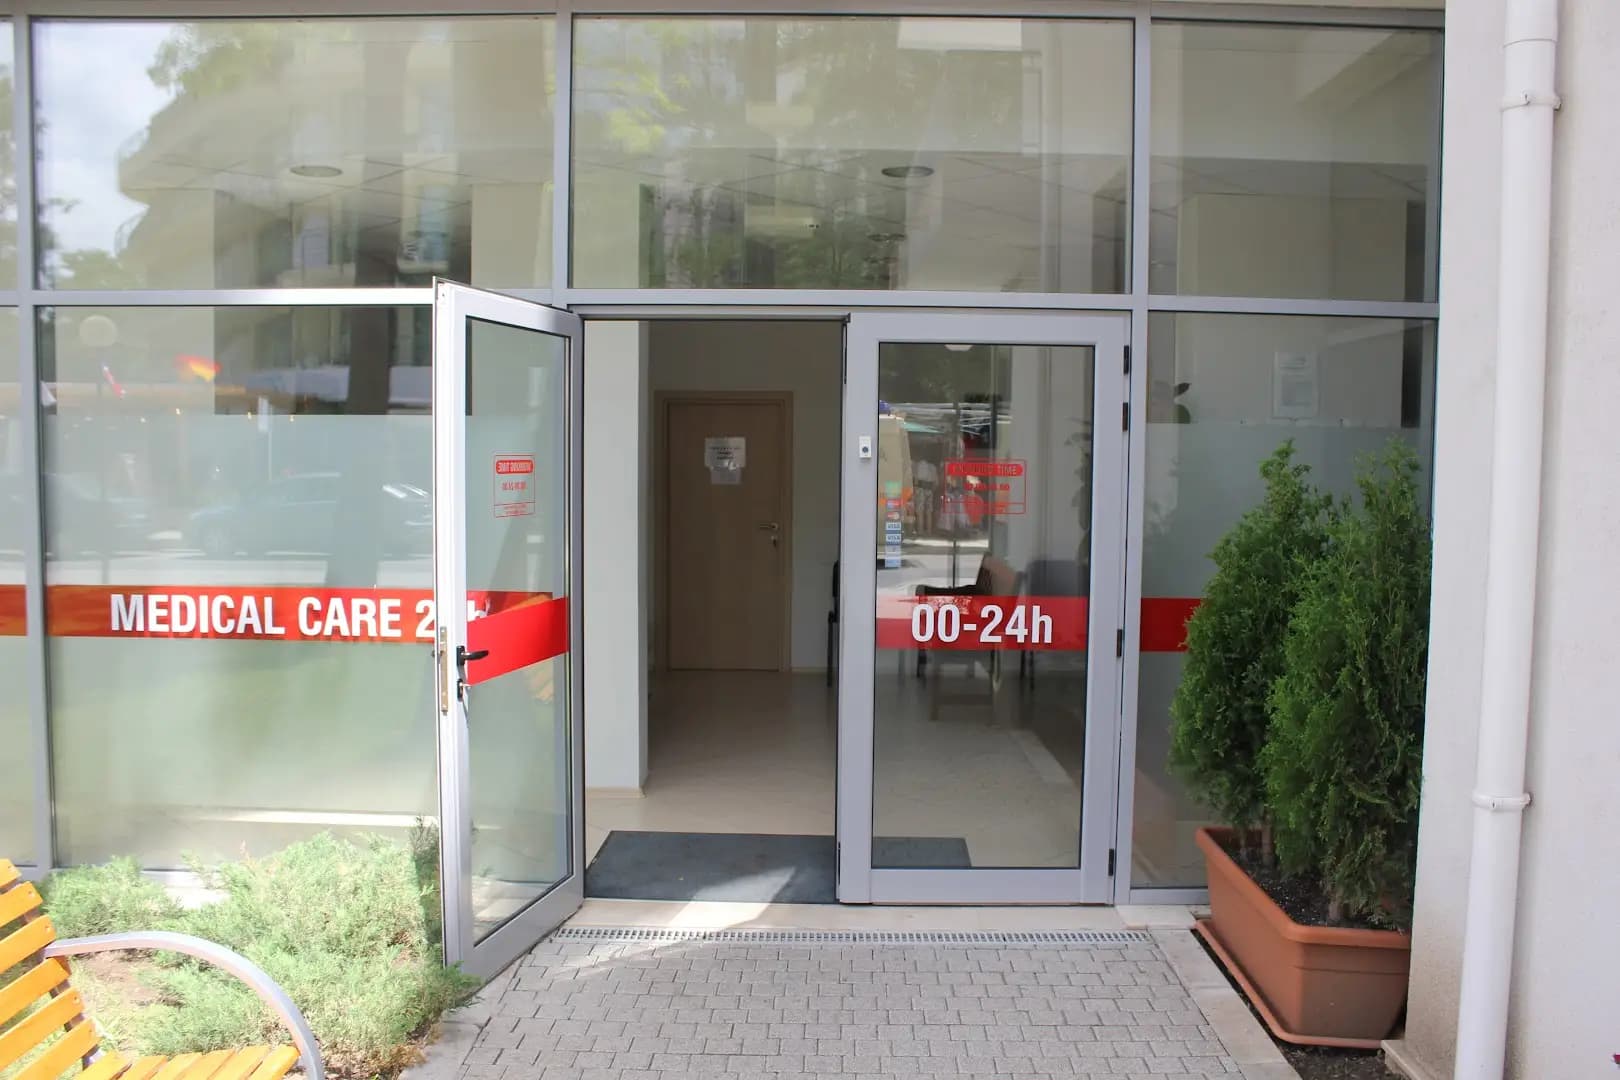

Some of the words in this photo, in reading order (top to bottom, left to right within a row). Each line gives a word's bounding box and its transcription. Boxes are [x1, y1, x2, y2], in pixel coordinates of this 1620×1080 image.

[111, 593, 284, 634] MEDICAL
[299, 597, 402, 636] CARE
[912, 604, 1052, 643] 00-24h
